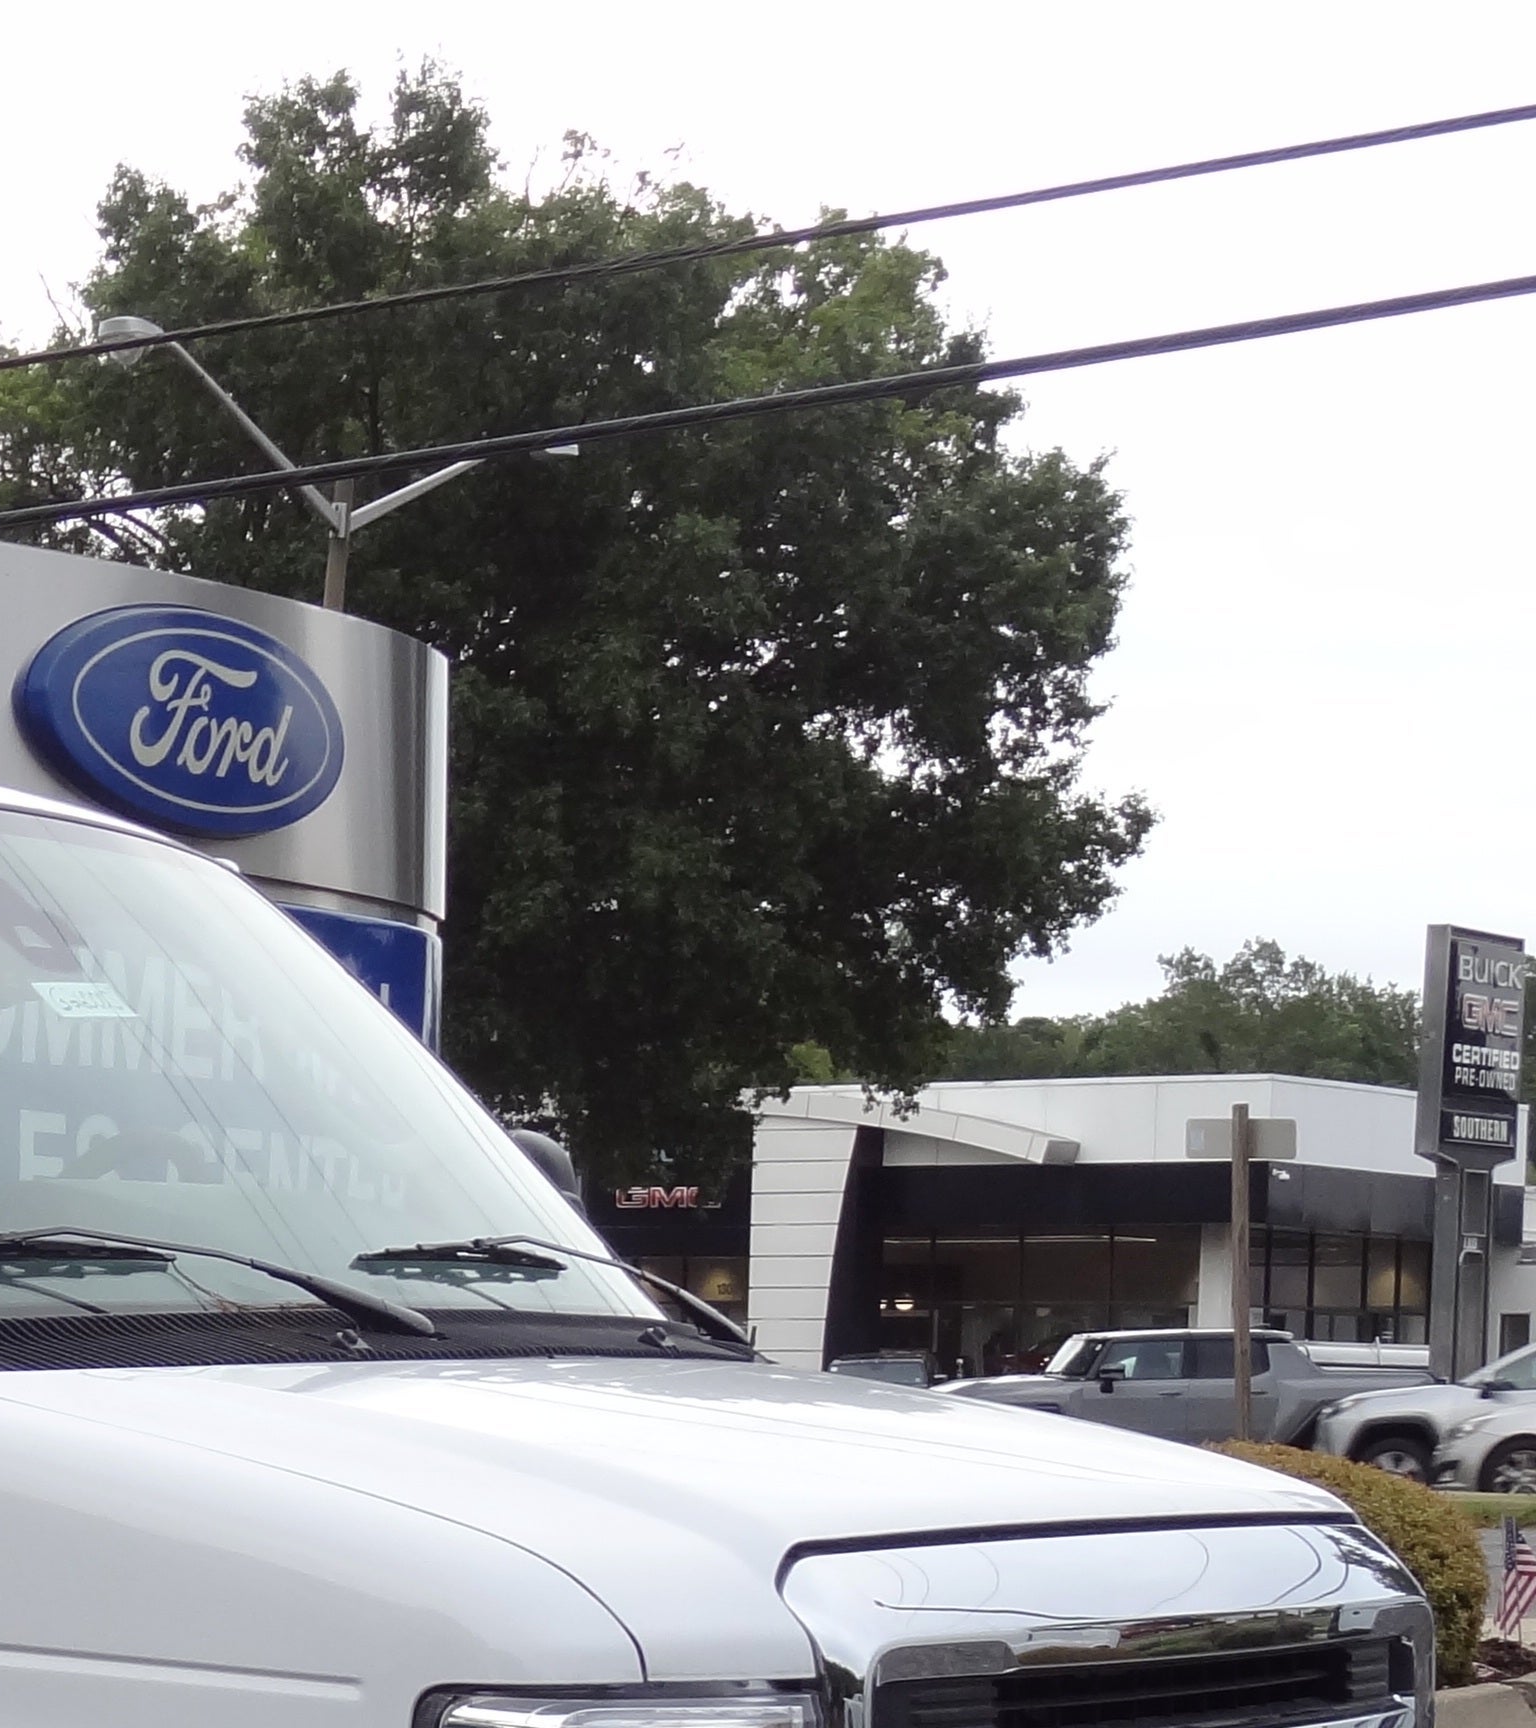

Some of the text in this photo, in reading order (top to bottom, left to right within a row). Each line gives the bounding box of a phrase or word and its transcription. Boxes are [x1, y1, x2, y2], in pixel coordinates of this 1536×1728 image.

[130, 650, 293, 786] Ford
[1458, 955, 1526, 989] BUICK
[1462, 993, 1520, 1037] GMC
[1452, 1043, 1520, 1070] CERTIFIED
[1454, 1066, 1516, 1091] PRE-OWNED
[1453, 1115, 1508, 1142] SOUTHERN
